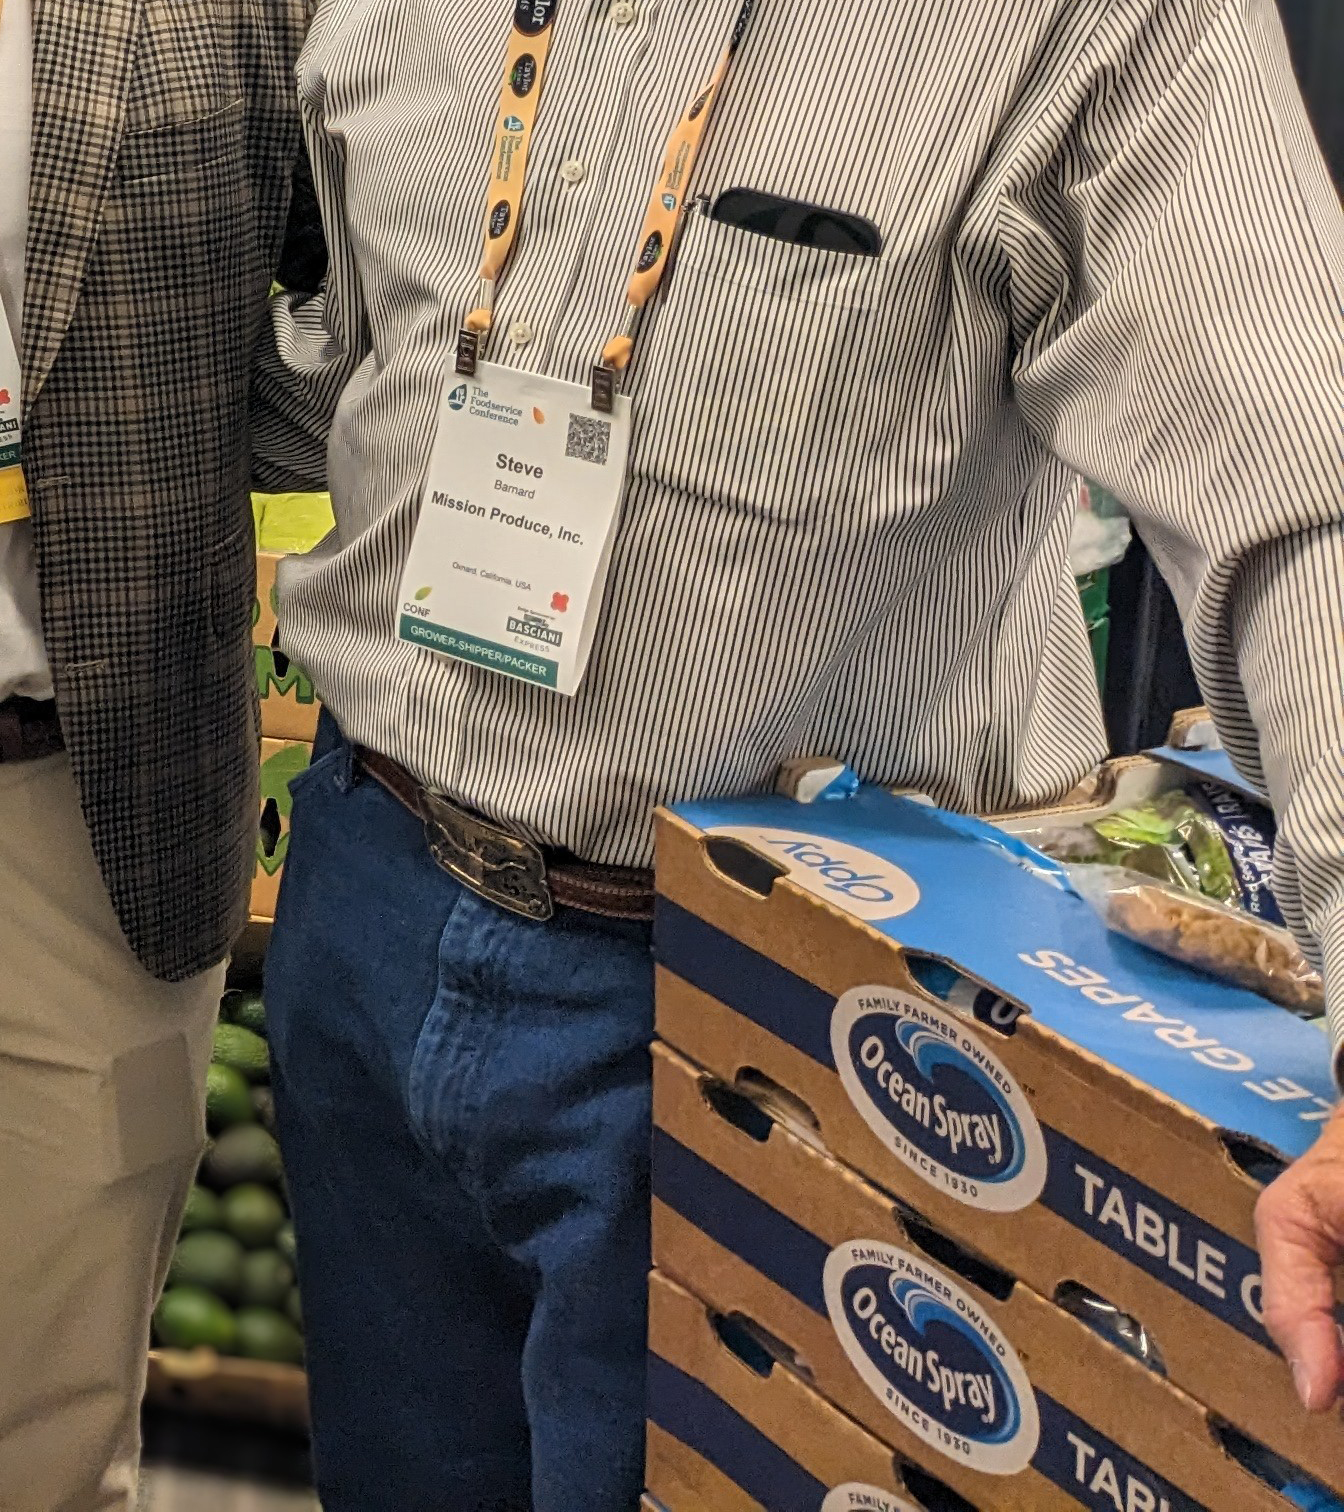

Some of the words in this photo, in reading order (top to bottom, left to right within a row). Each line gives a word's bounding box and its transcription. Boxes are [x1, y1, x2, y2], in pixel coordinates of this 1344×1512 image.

[469, 406, 519, 426] Conference
[470, 396, 523, 417] Foodservice
[472, 386, 489, 398] The
[494, 479, 536, 499] Barnard
[496, 453, 544, 479] Steve
[431, 490, 486, 518] Mission
[490, 507, 554, 539] Produce,
[557, 525, 584, 546] Inc.
[403, 602, 431, 618] CONF
[515, 579, 532, 591] USA
[410, 625, 548, 677] GROWER-SHIPPER/PACKER
[509, 619, 561, 644] BASCIANI
[764, 837, 894, 903] Oppy
[1017, 949, 1256, 1072] GRAPES
[857, 996, 901, 1013] FAMILY
[903, 1003, 959, 1040] FARMER
[961, 1040, 1012, 1095] OWNED
[860, 1035, 931, 1128] Ocean
[932, 1094, 1003, 1164] Spray
[894, 1136, 937, 1178] SINCE
[944, 1172, 979, 1198] 1930
[1074, 1163, 1227, 1299] TABLE
[850, 1248, 895, 1266] FAMILY
[897, 1256, 953, 1301] FARMER
[956, 1298, 1007, 1358] OWNED
[852, 1287, 924, 1382] Ocean
[926, 1350, 996, 1424] Spray
[885, 1387, 931, 1432] SINCE
[937, 1426, 972, 1456] 1930
